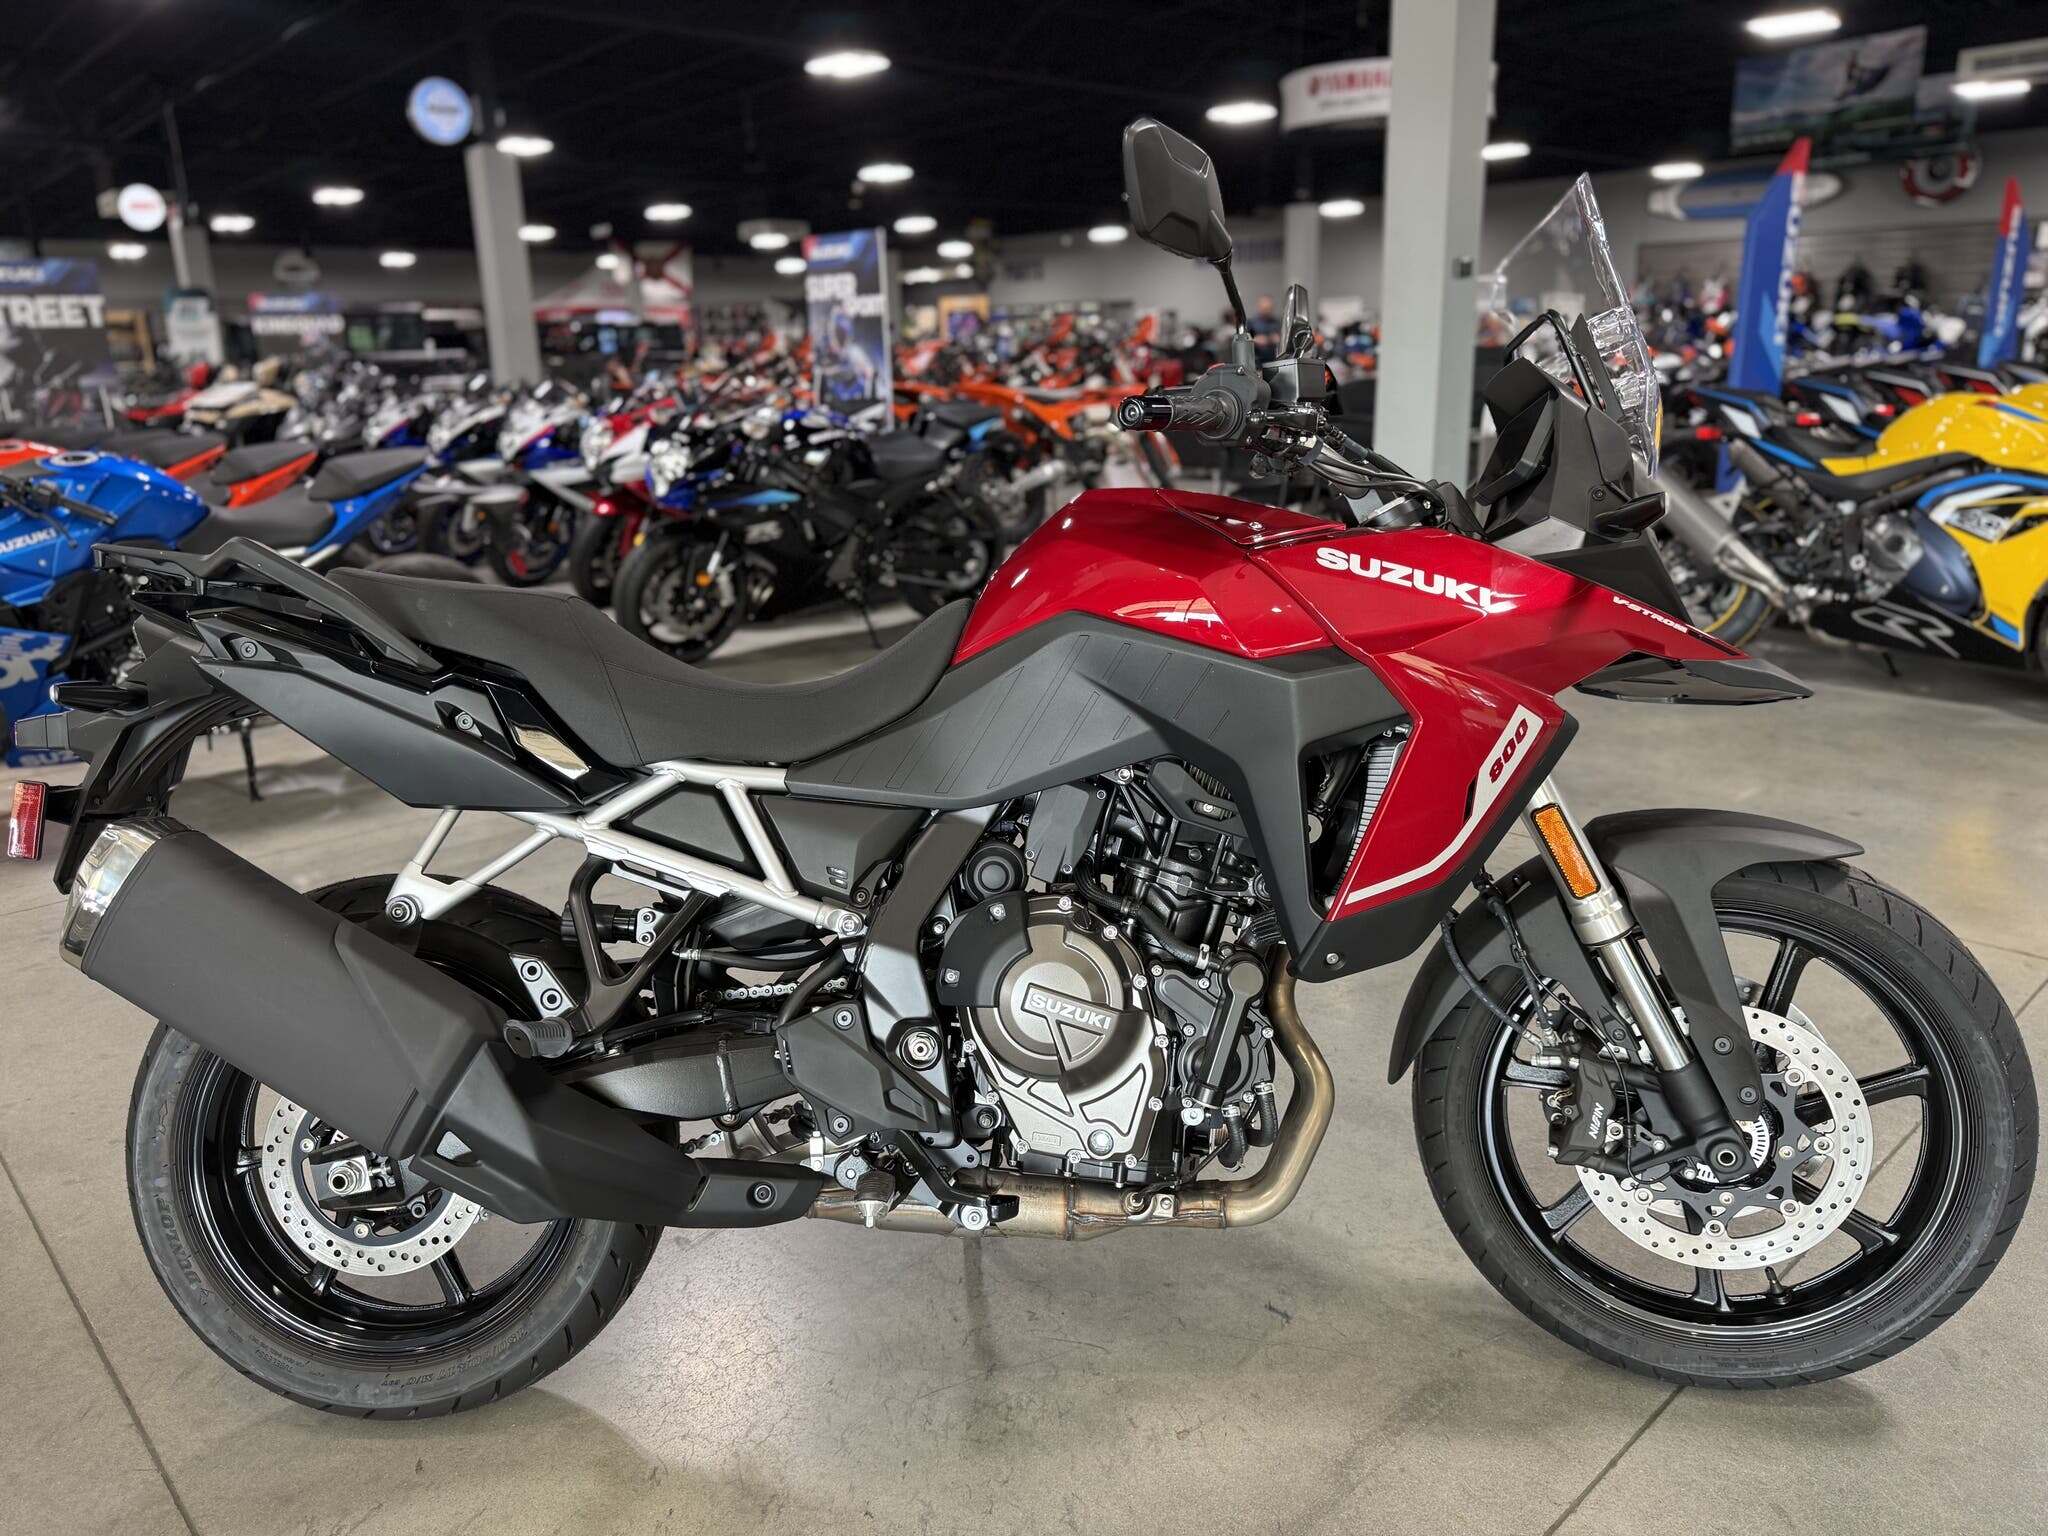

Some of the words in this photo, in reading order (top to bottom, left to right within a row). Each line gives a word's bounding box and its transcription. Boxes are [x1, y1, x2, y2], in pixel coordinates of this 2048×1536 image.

[1316, 547, 1497, 613] SUZUKI
[1489, 717, 1529, 784] 800
[1030, 992, 1113, 1030] SUZUKI
